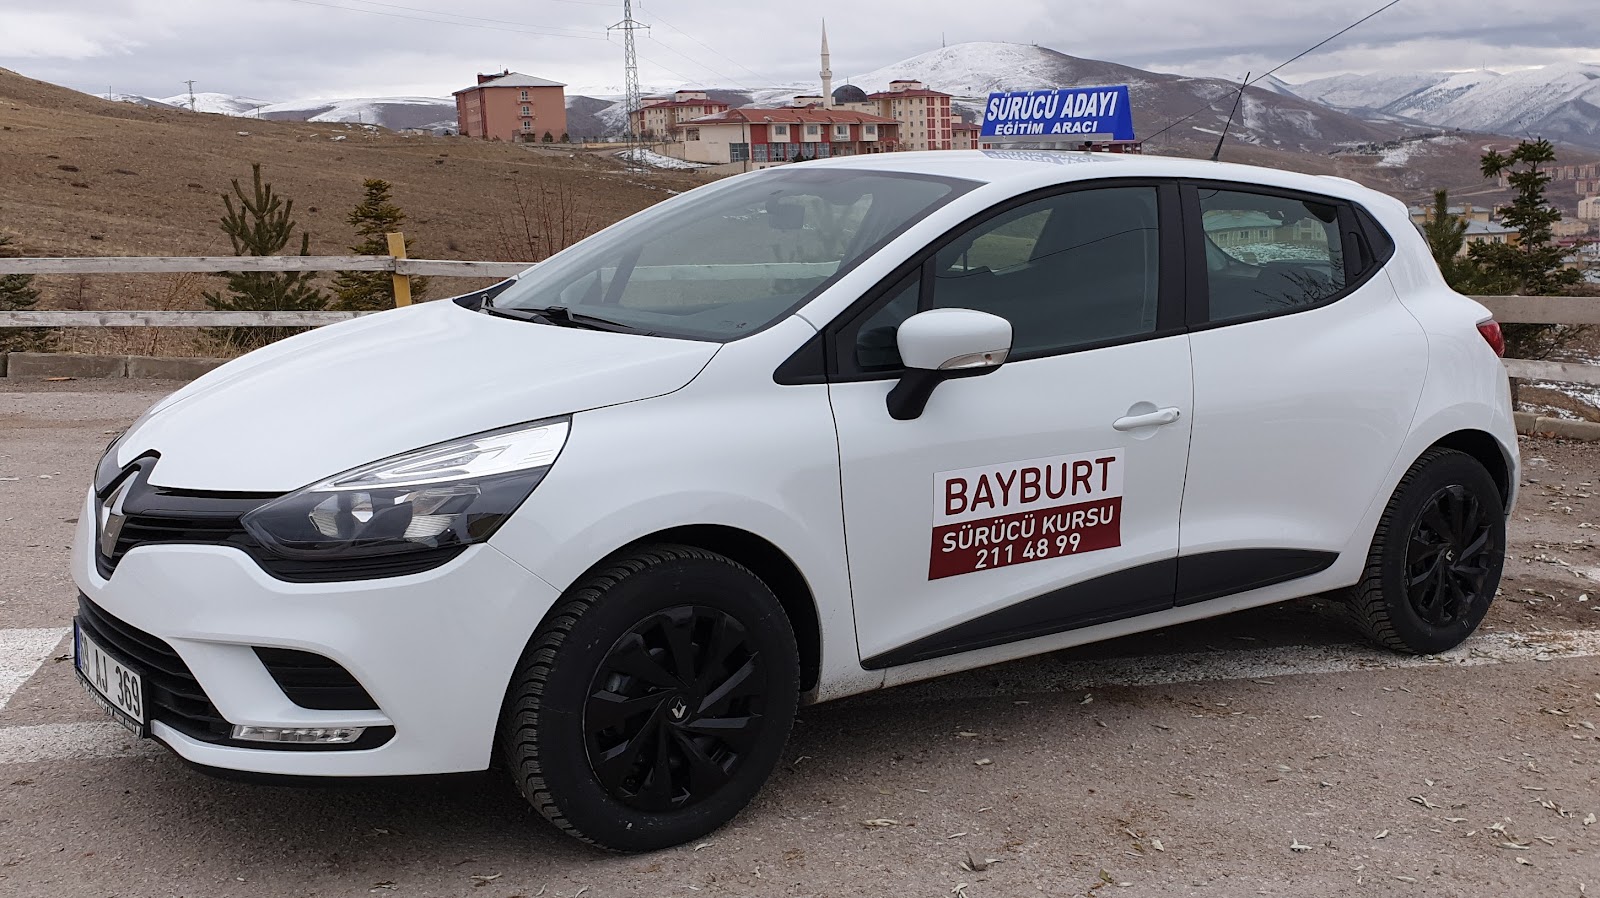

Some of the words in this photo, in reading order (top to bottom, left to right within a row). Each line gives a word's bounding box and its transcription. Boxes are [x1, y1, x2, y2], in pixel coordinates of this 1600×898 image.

[987, 90, 1060, 121] SÜRÜCÜ
[1060, 91, 1118, 119] ADAYI
[994, 120, 1044, 135] EĞİTİM
[1051, 121, 1098, 134] ARACI
[945, 456, 1116, 516] BAYBURT
[942, 513, 1036, 553] SÜRÜCÜ
[1042, 505, 1114, 535] KURSU
[975, 544, 1014, 569] 211
[1022, 538, 1049, 560] 48
[1055, 532, 1081, 554] 99
[95, 648, 108, 694] AJ
[115, 665, 141, 717] 369
